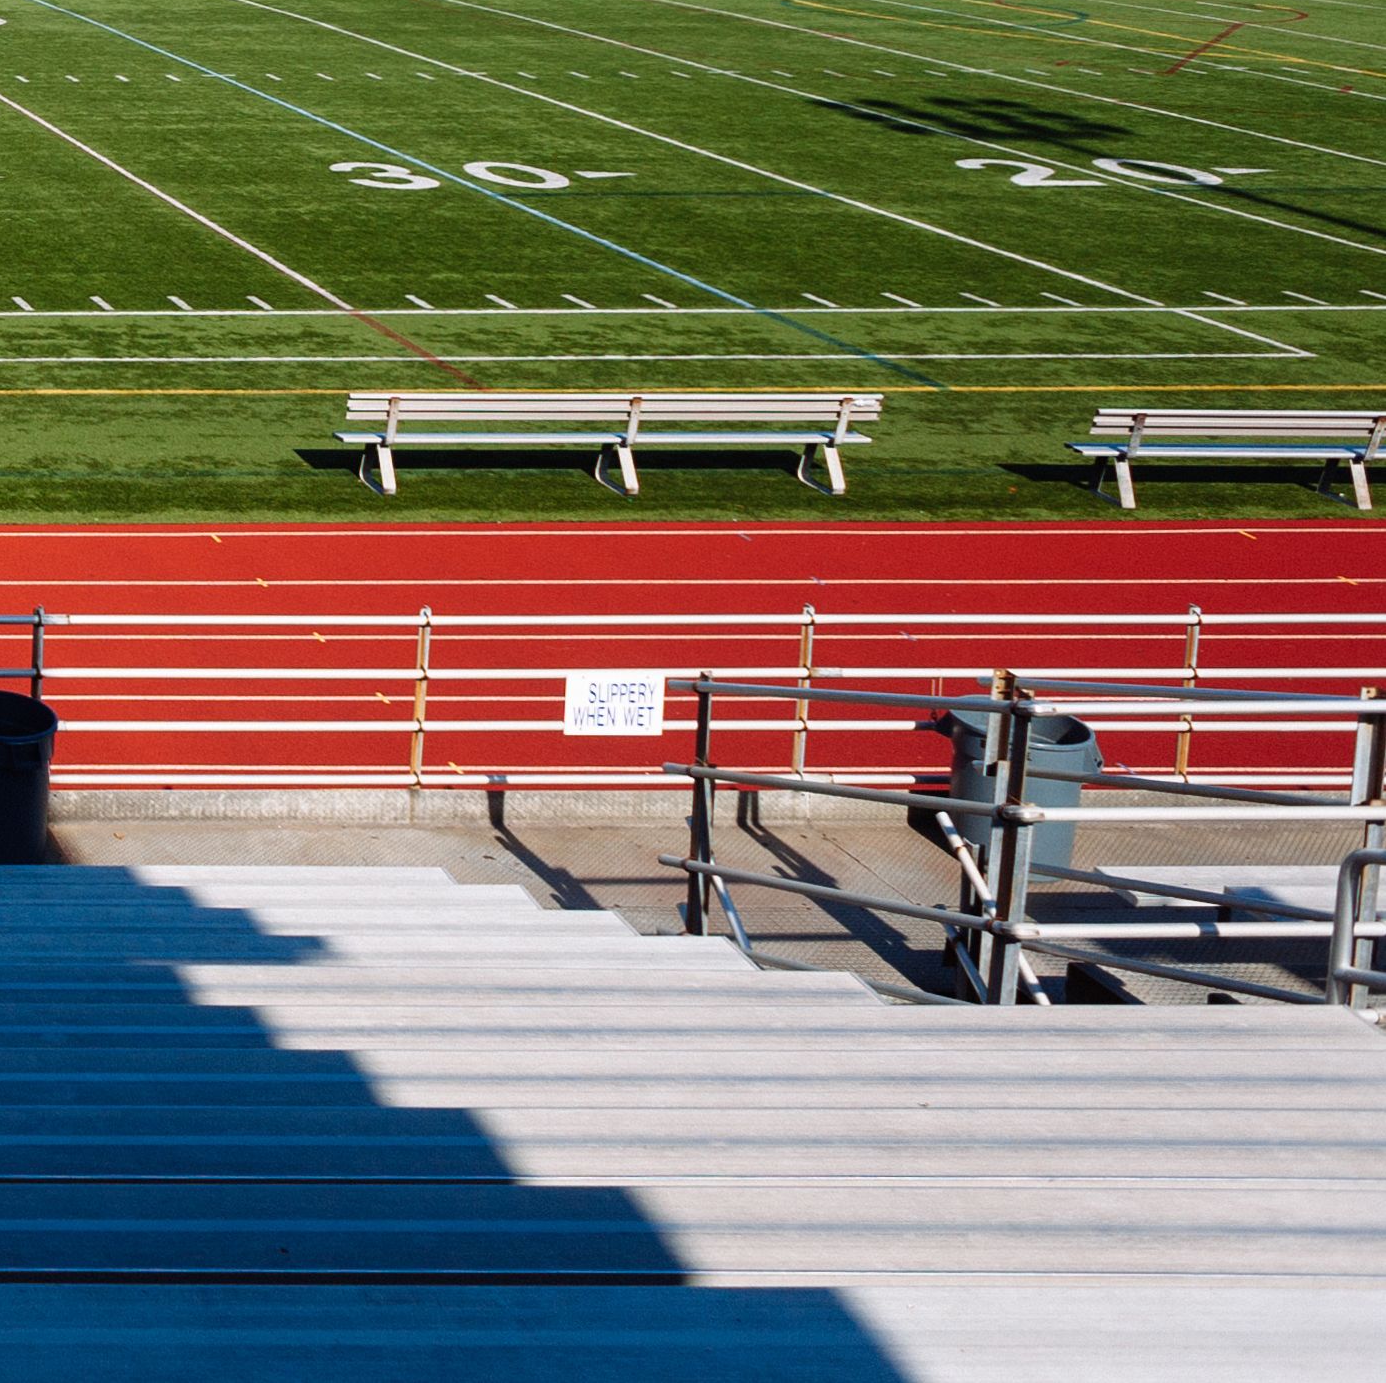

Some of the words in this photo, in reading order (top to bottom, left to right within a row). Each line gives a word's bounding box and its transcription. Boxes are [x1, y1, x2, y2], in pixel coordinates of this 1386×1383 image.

[329, 161, 570, 190] 30
[588, 683, 656, 704] SLIPPERY
[573, 707, 615, 726] WHEN
[623, 706, 654, 726] WET
